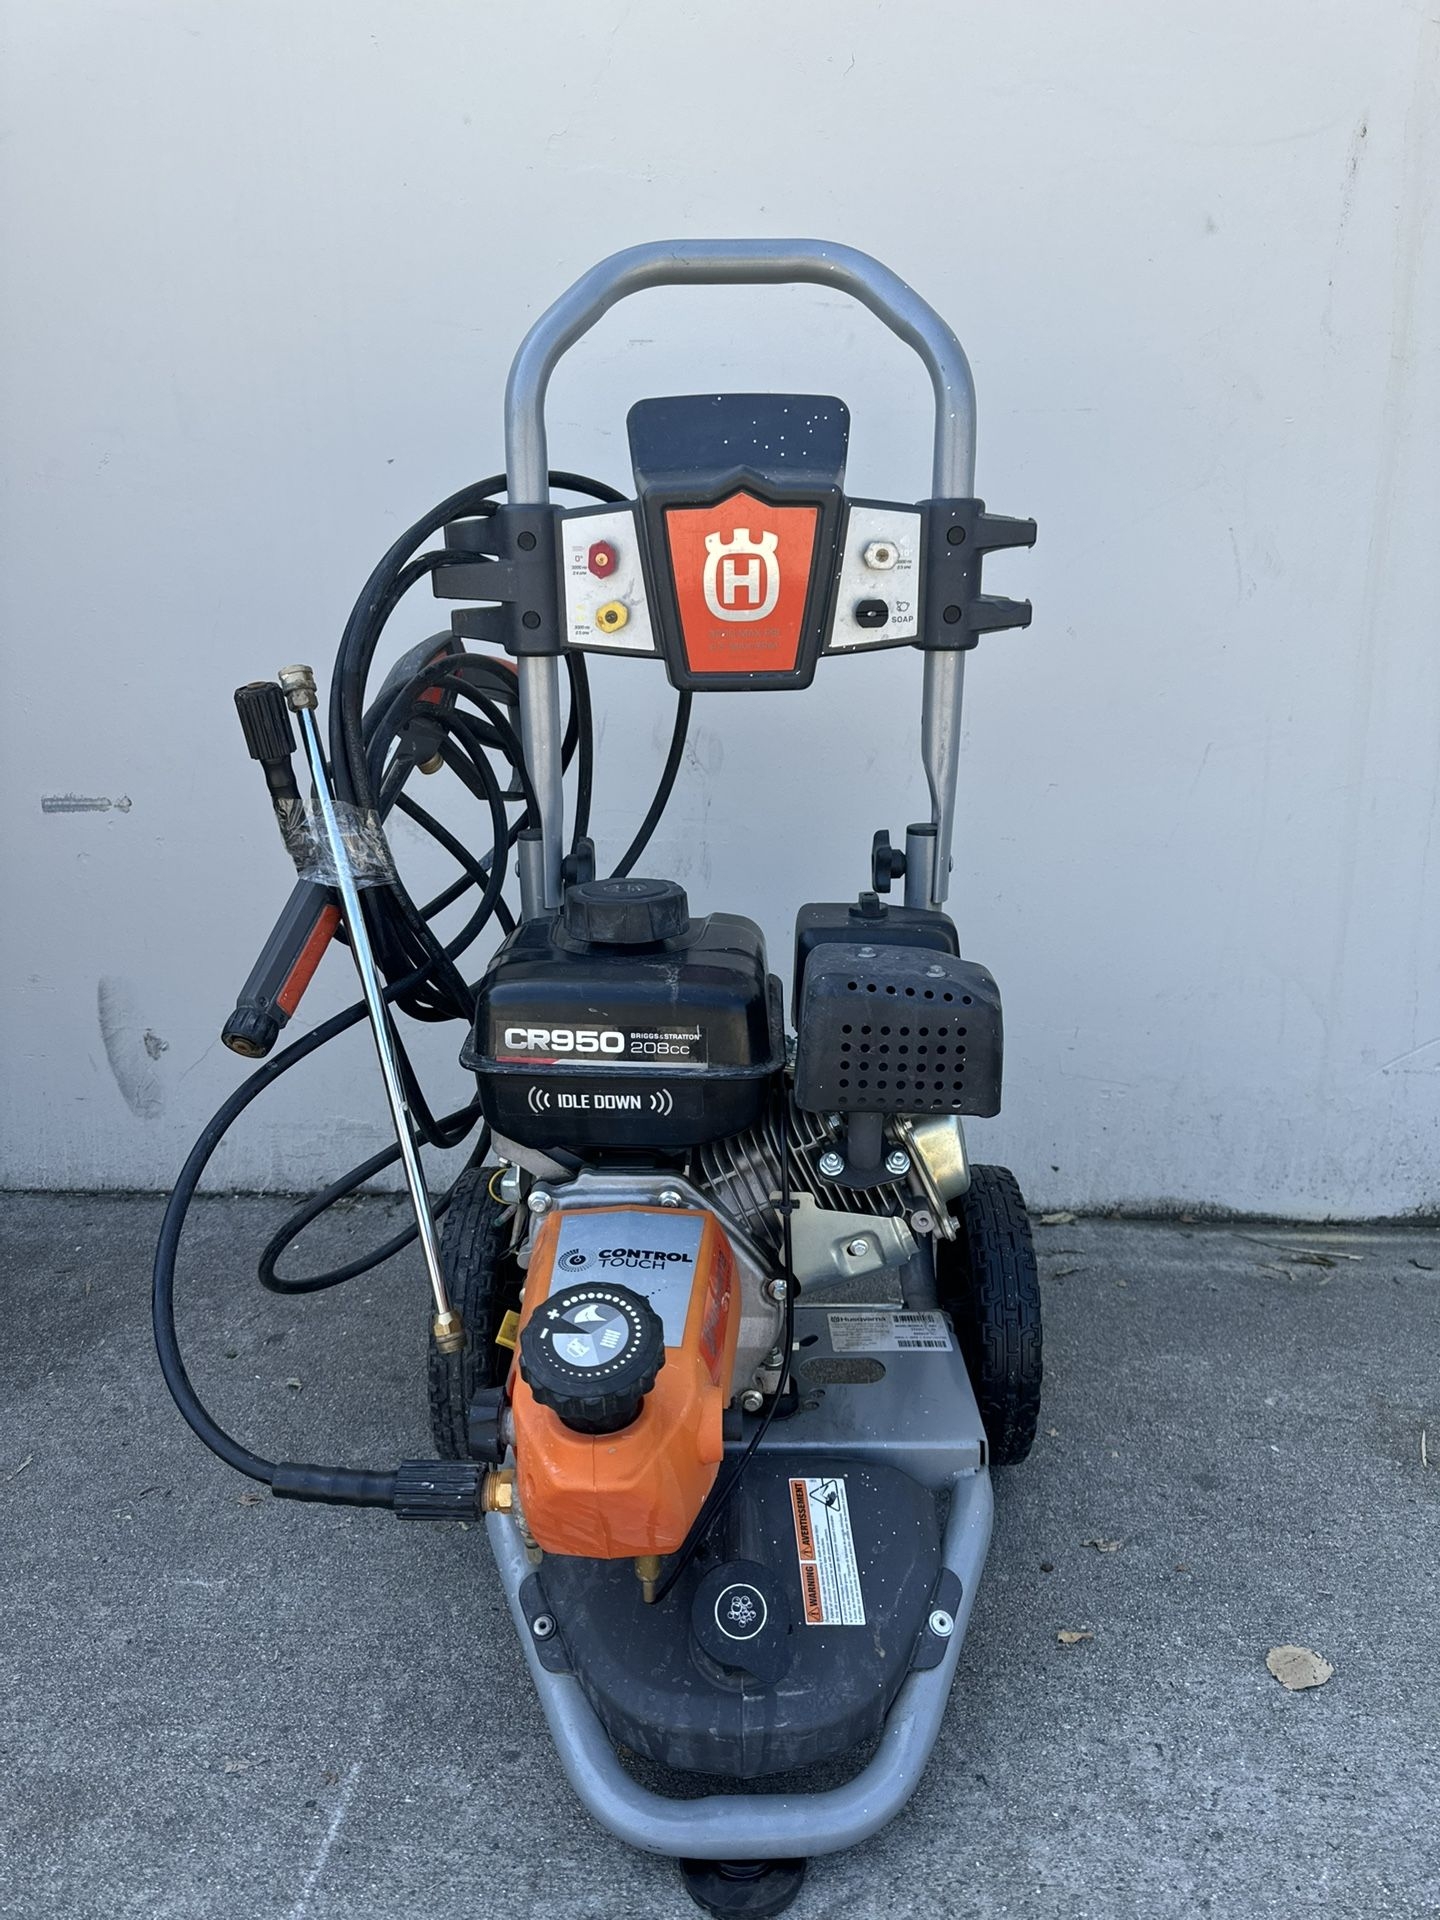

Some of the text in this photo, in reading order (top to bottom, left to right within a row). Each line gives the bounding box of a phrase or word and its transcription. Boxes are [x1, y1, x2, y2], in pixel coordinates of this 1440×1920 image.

[504, 1027, 625, 1053] CR950
[630, 1042, 690, 1055] 208cc
[558, 1094, 641, 1110] IDLE DOWN
[598, 1248, 693, 1263] CONTROL
[598, 1257, 665, 1270] TOUCH
[794, 1483, 811, 1545] AVERTISSEMENT
[805, 1566, 817, 1607] WARNING
